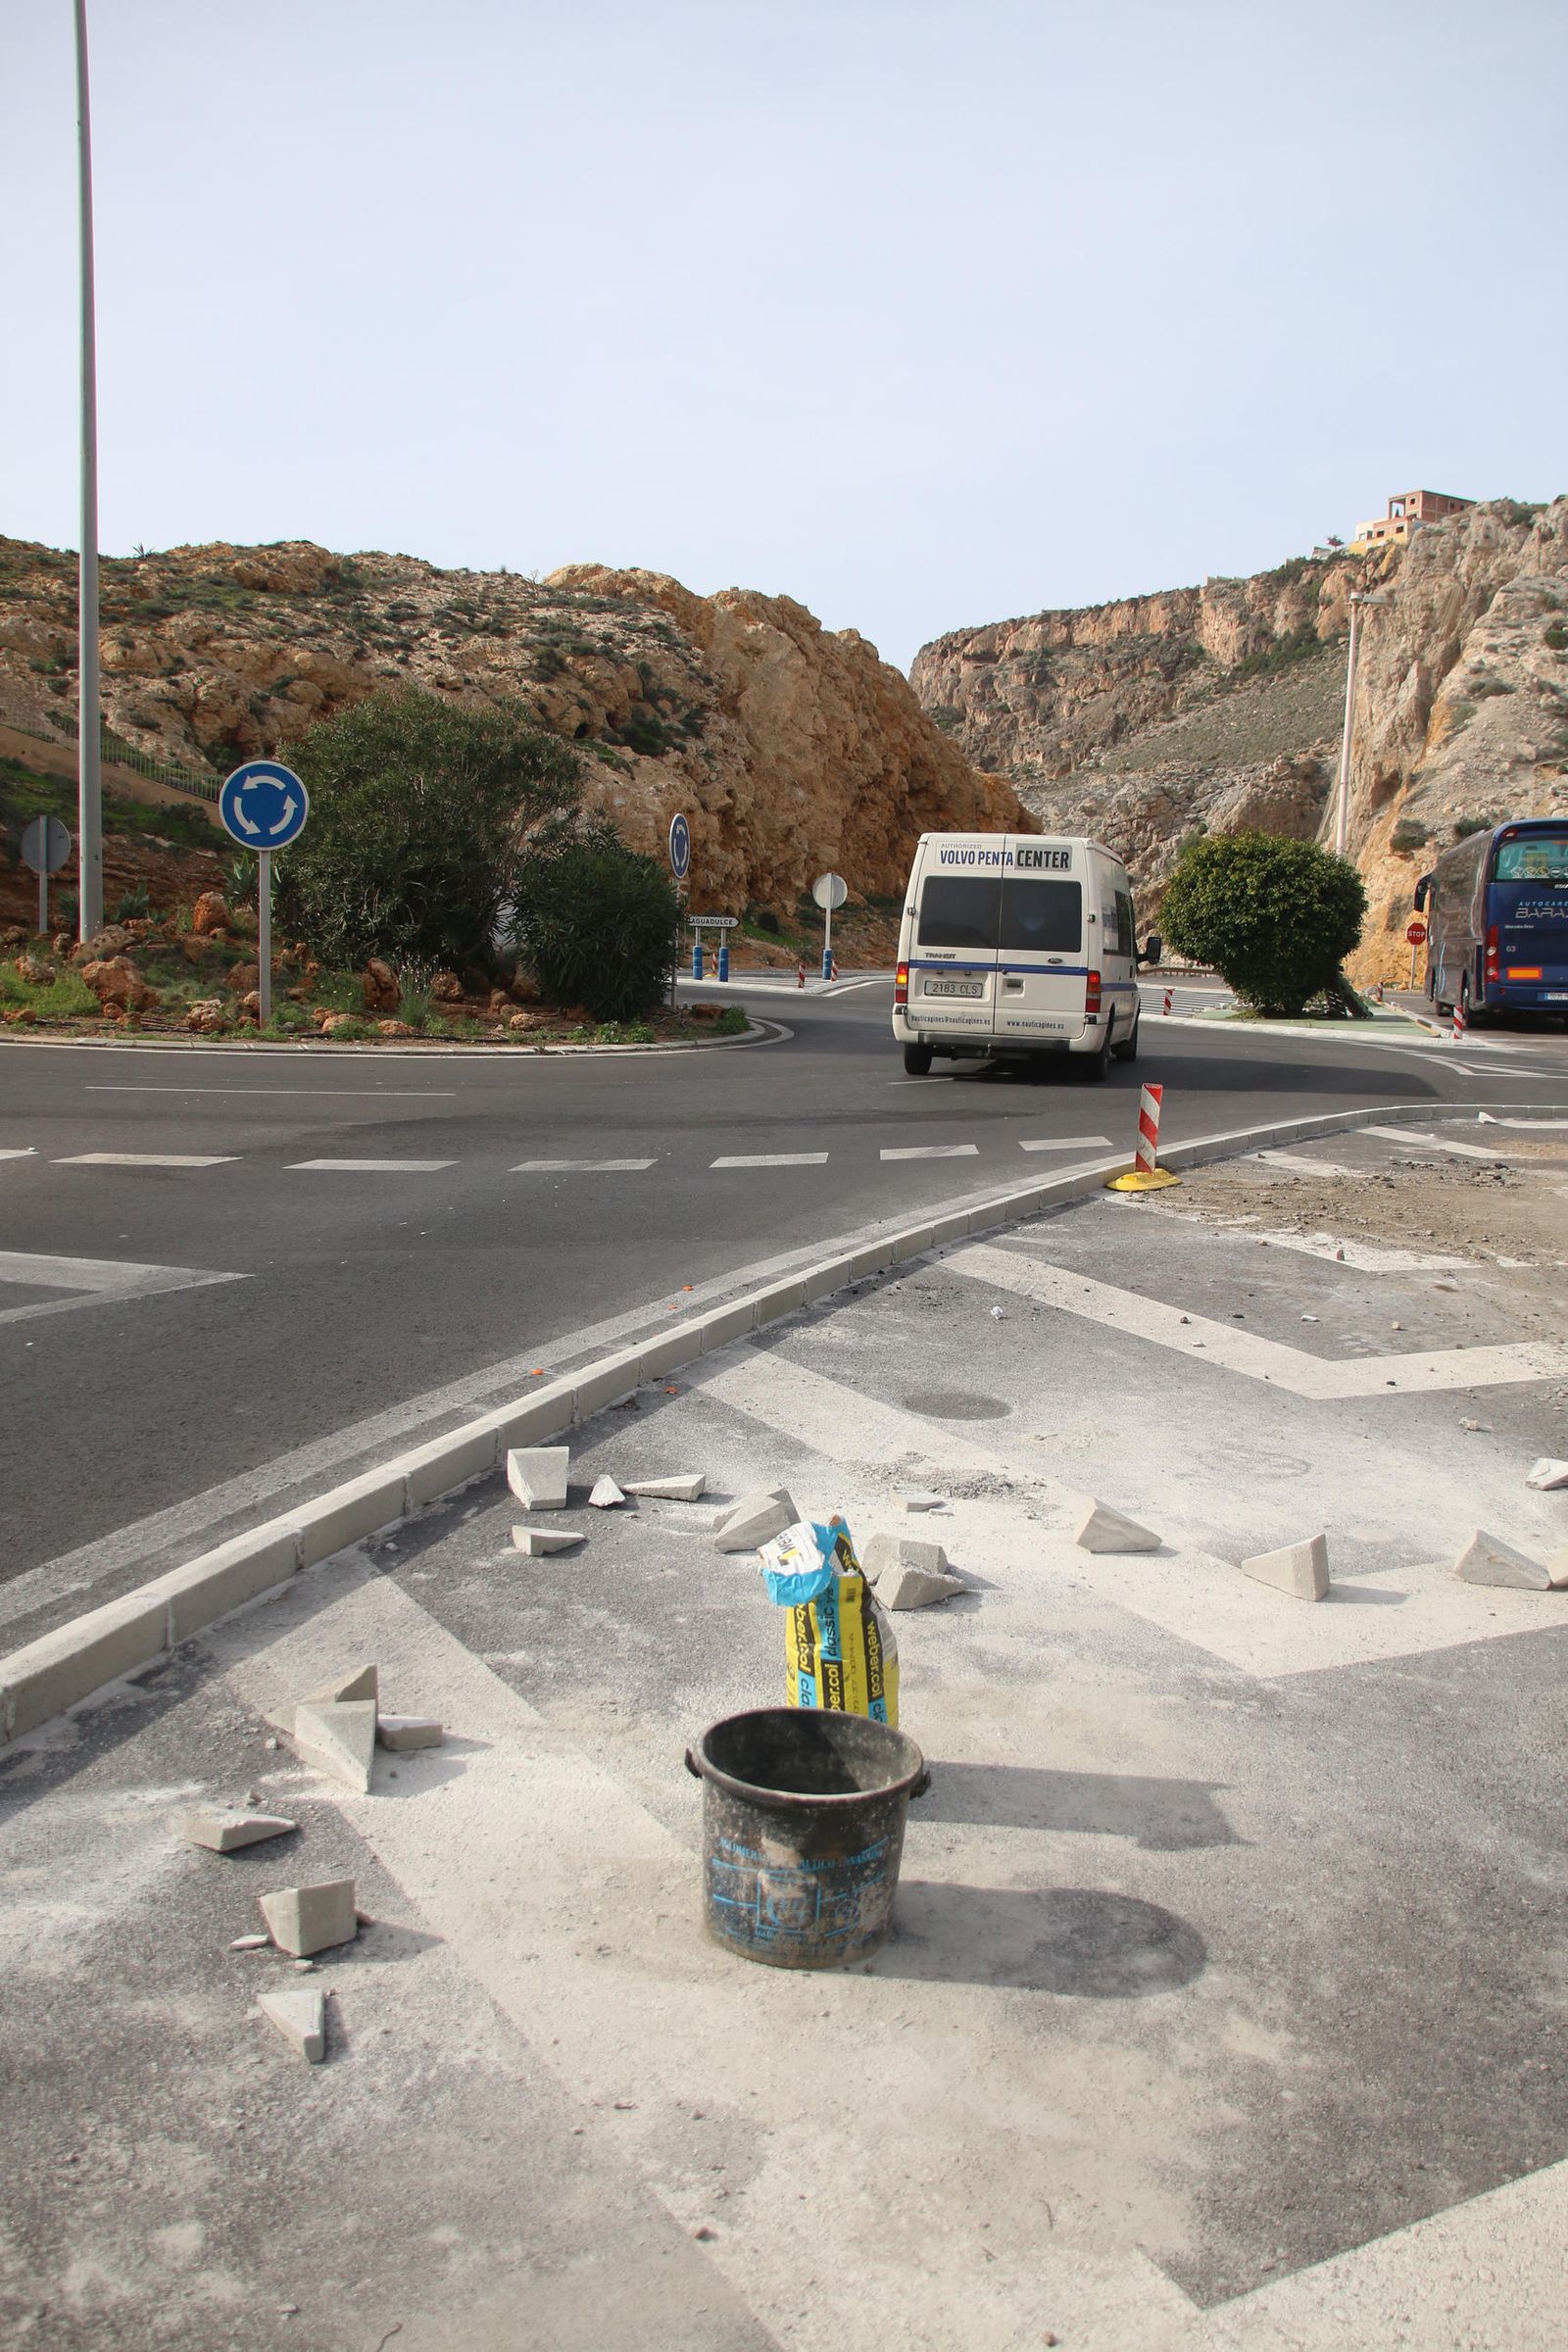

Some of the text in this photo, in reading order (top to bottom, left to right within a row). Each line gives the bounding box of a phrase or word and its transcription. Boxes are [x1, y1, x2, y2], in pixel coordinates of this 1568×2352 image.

[940, 850, 1069, 869] VOLVO PENTA CENTER
[1515, 907, 1568, 918] BARA
[932, 983, 978, 995] 2183 CLS
[1006, 1019, 1064, 1029] www.nauticagines.es
[797, 1603, 811, 1672] ber.col
[820, 1607, 838, 1656] classic
[866, 1621, 882, 1697] weber.col
